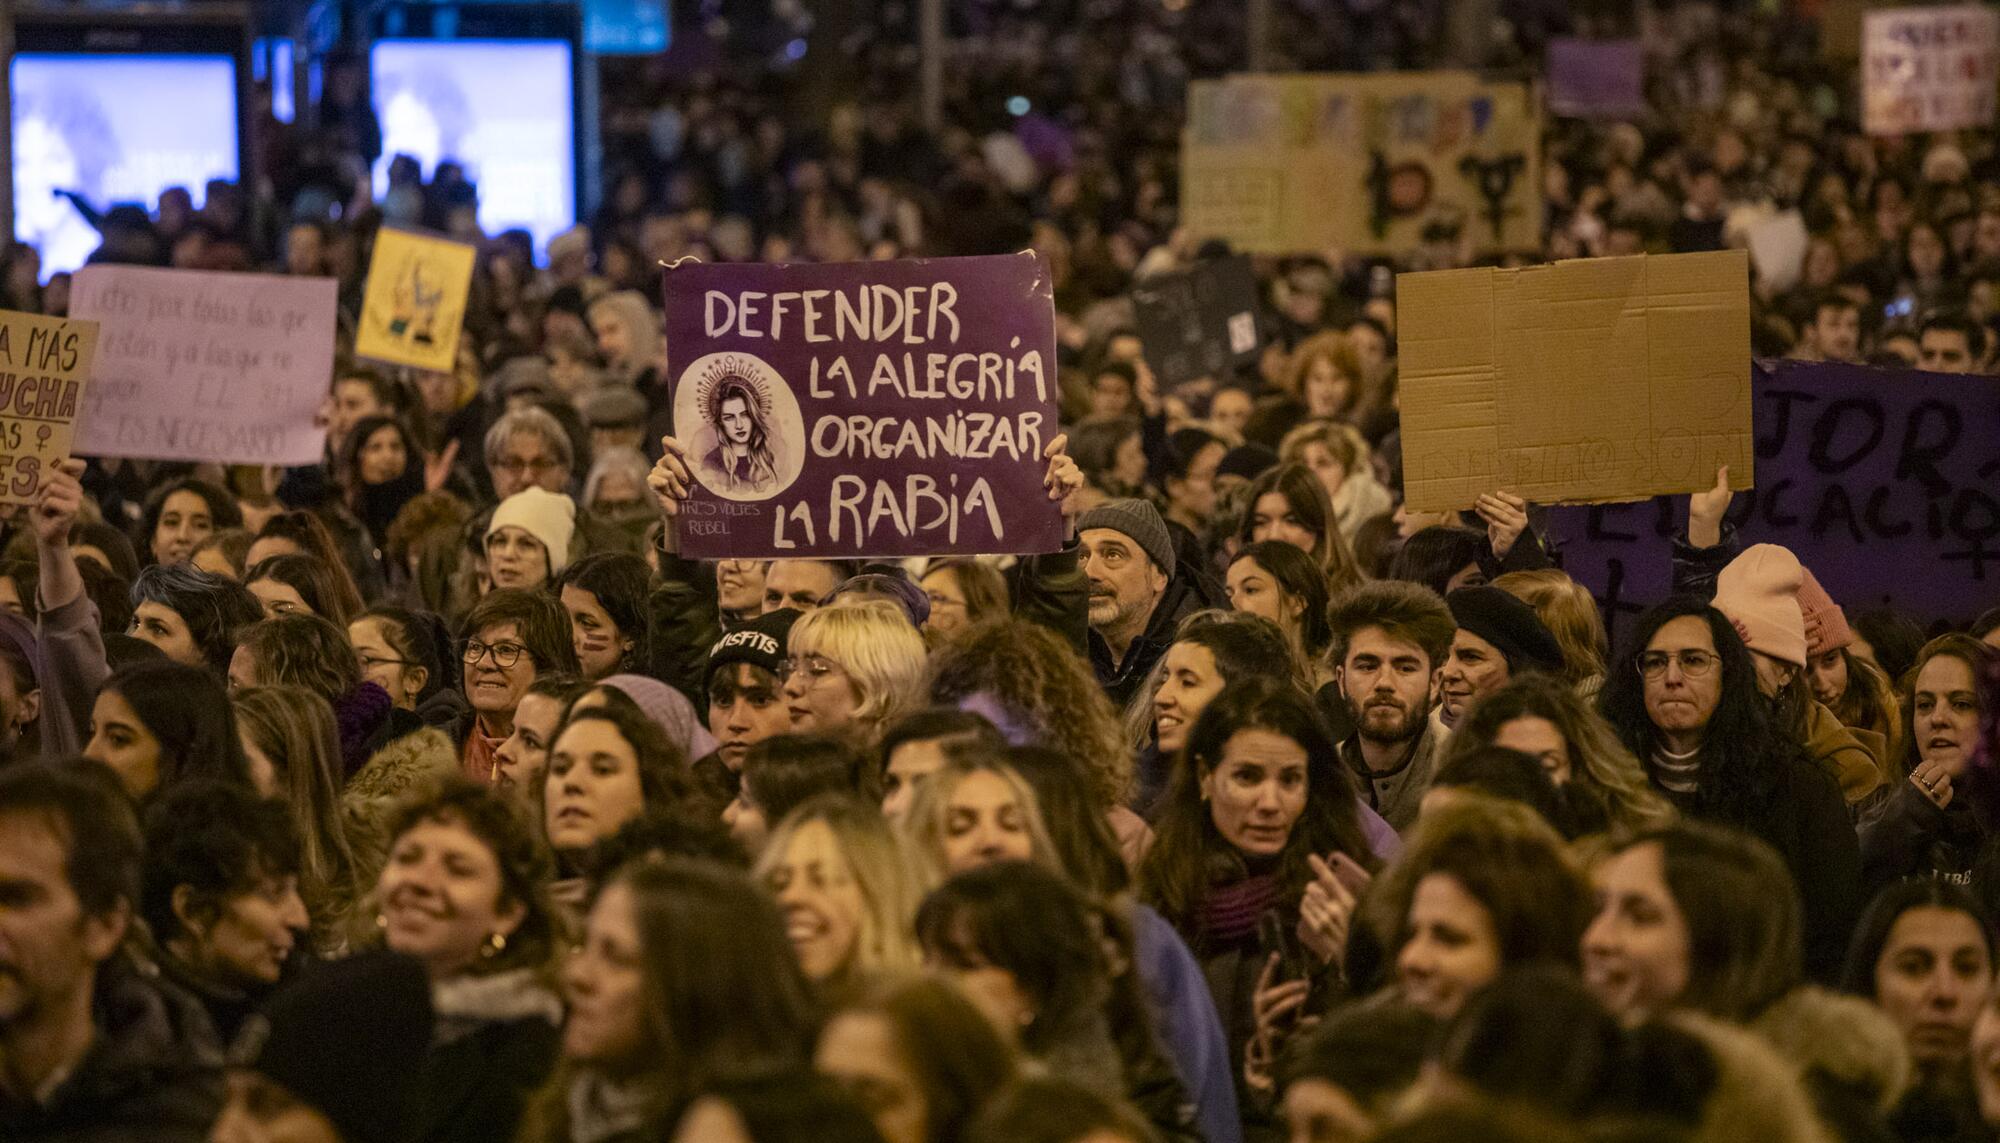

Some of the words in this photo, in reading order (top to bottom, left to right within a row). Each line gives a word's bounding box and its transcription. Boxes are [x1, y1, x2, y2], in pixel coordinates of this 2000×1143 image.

[704, 281, 961, 344] DEFENDER
[25, 321, 79, 373] MÁS
[809, 355, 857, 400] LA
[688, 520, 731, 536] REBEL
[773, 502, 816, 549] LA
